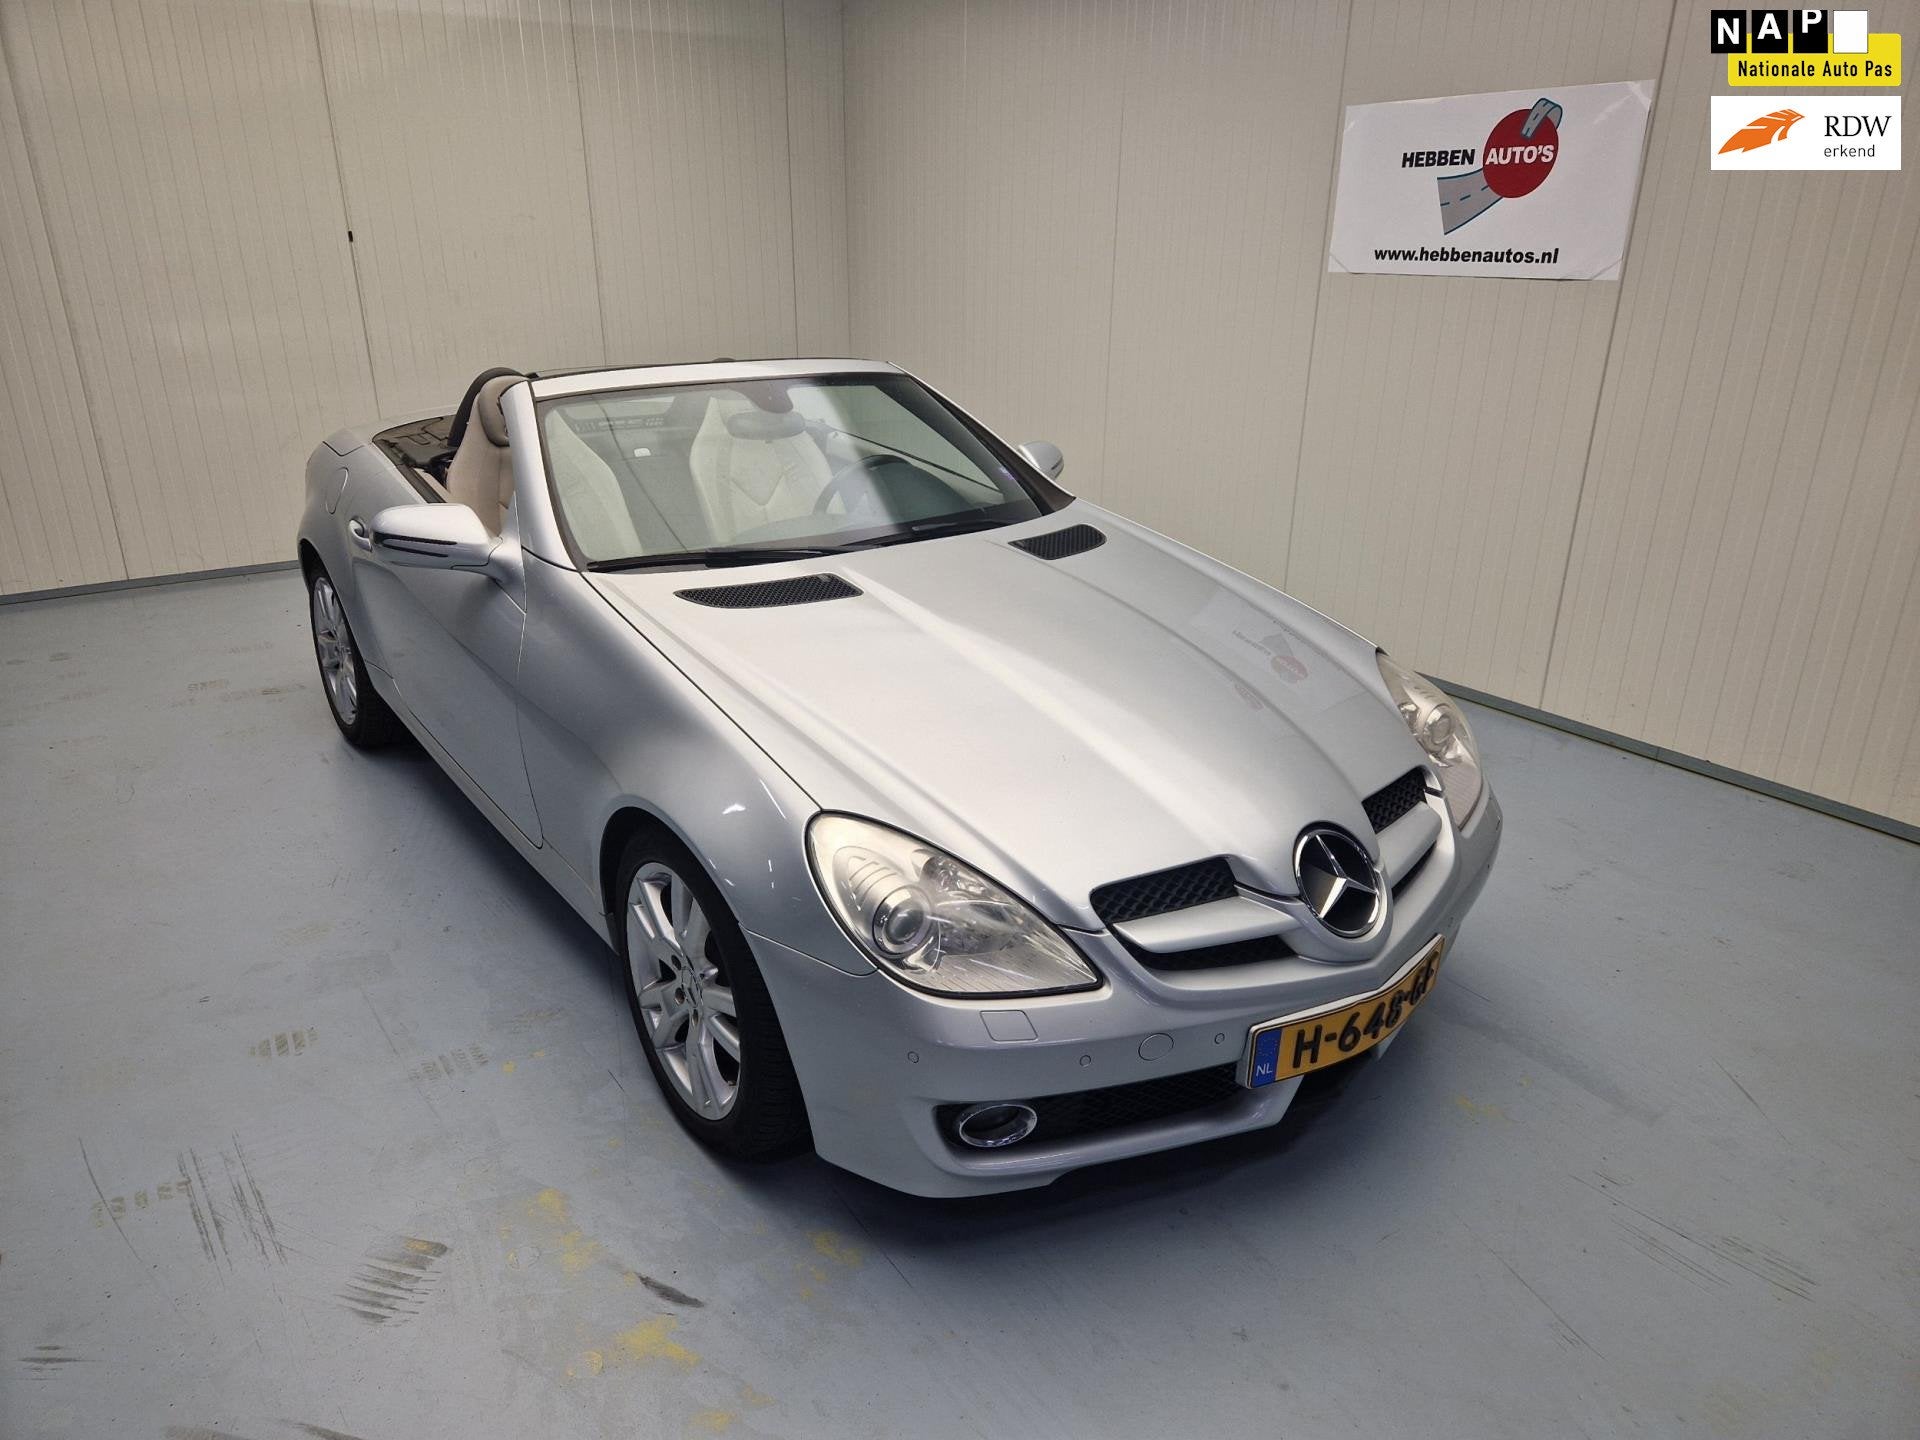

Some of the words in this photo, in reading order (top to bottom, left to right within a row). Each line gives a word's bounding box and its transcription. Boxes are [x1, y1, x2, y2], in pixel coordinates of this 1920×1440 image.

[1401, 148, 1475, 168] HEBBEN
[1485, 144, 1554, 166] AUTO'S
[1374, 247, 1559, 264] www.hebbenautos.nl
[1255, 1062, 1273, 1077] NL
